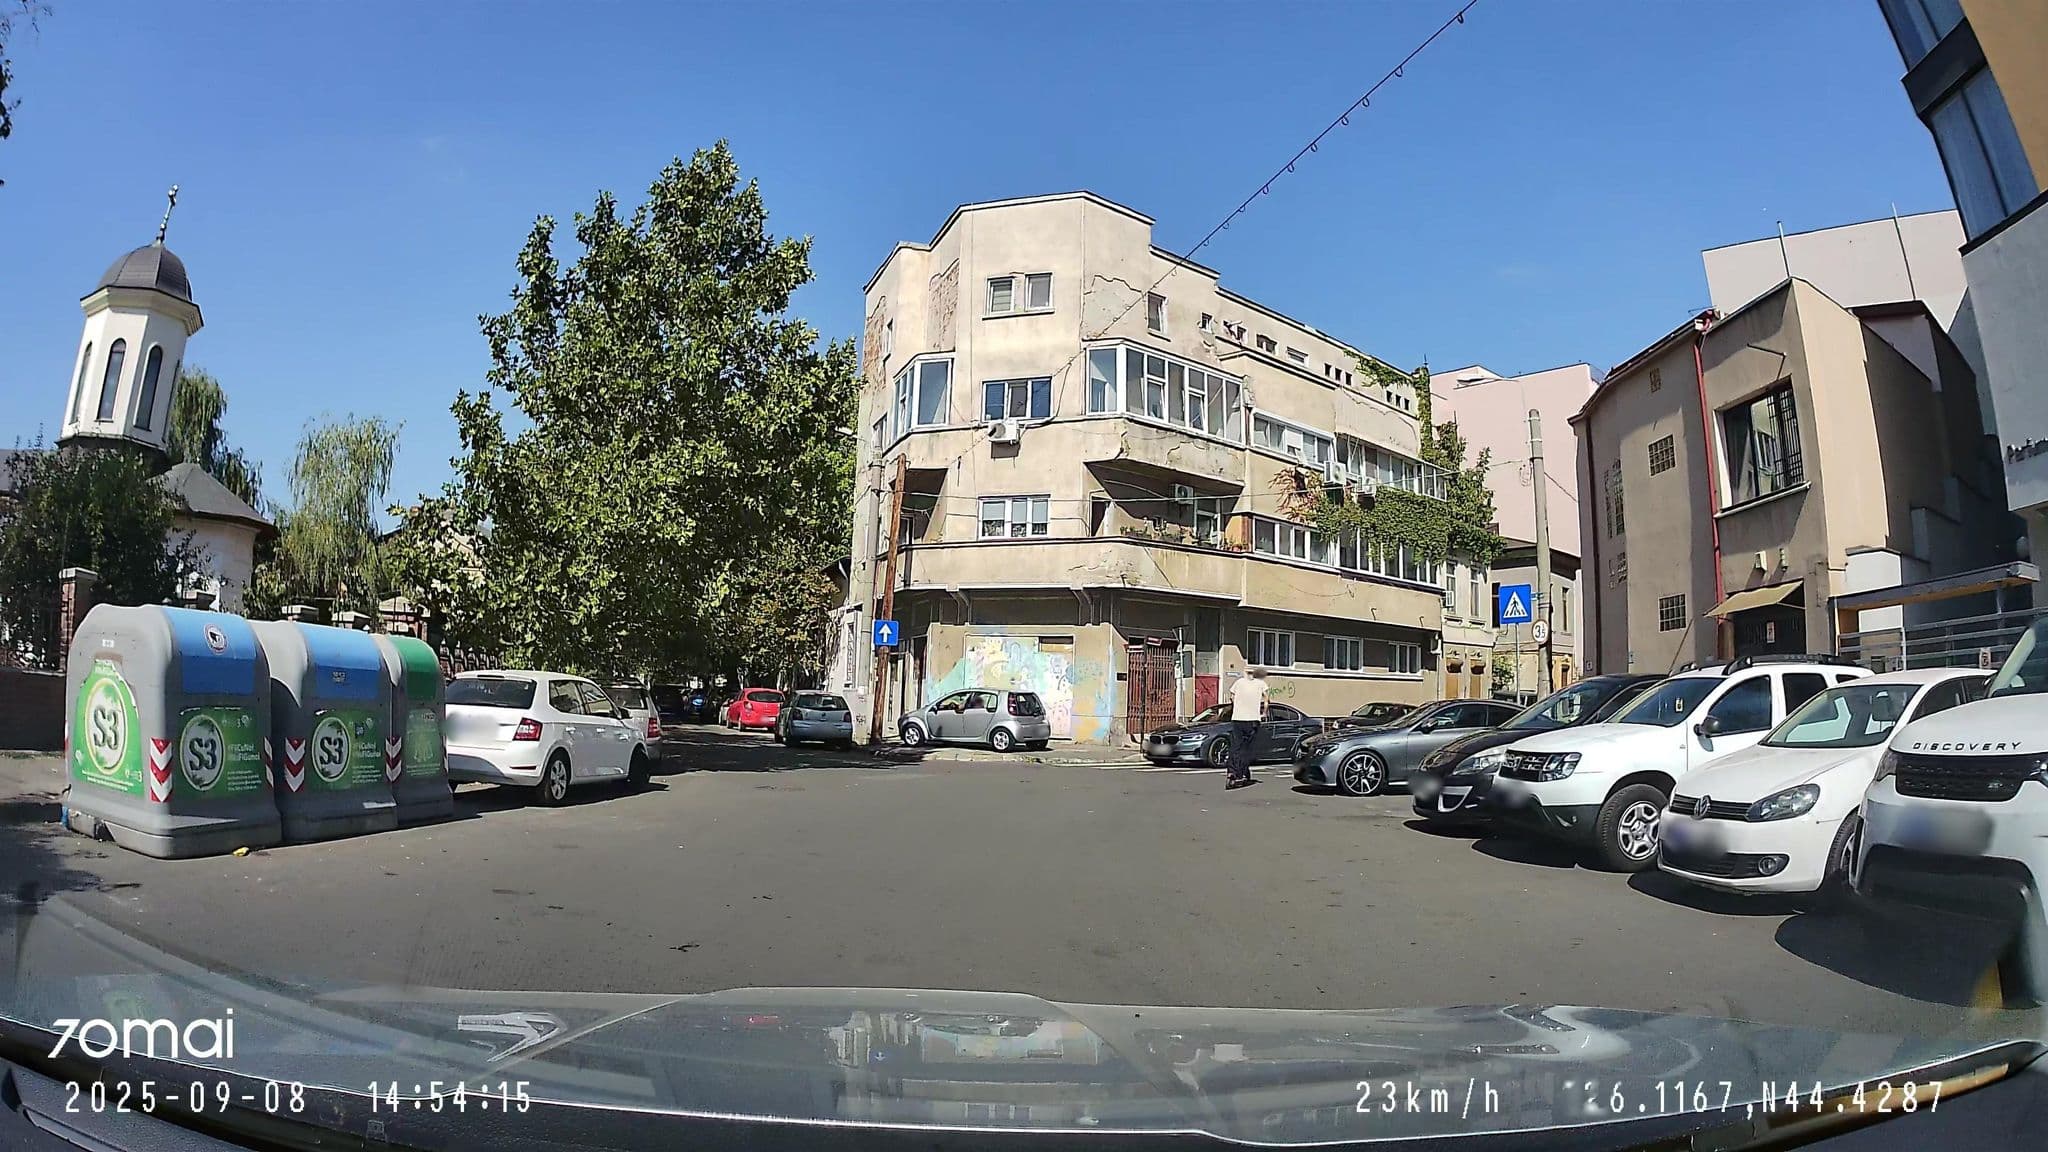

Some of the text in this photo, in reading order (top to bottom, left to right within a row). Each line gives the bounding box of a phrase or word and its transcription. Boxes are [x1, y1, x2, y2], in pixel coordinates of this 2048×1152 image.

[93, 705, 118, 750] S3
[189, 738, 216, 770] S3
[319, 736, 343, 764] S3
[1913, 742, 2021, 751] DISCOVERY
